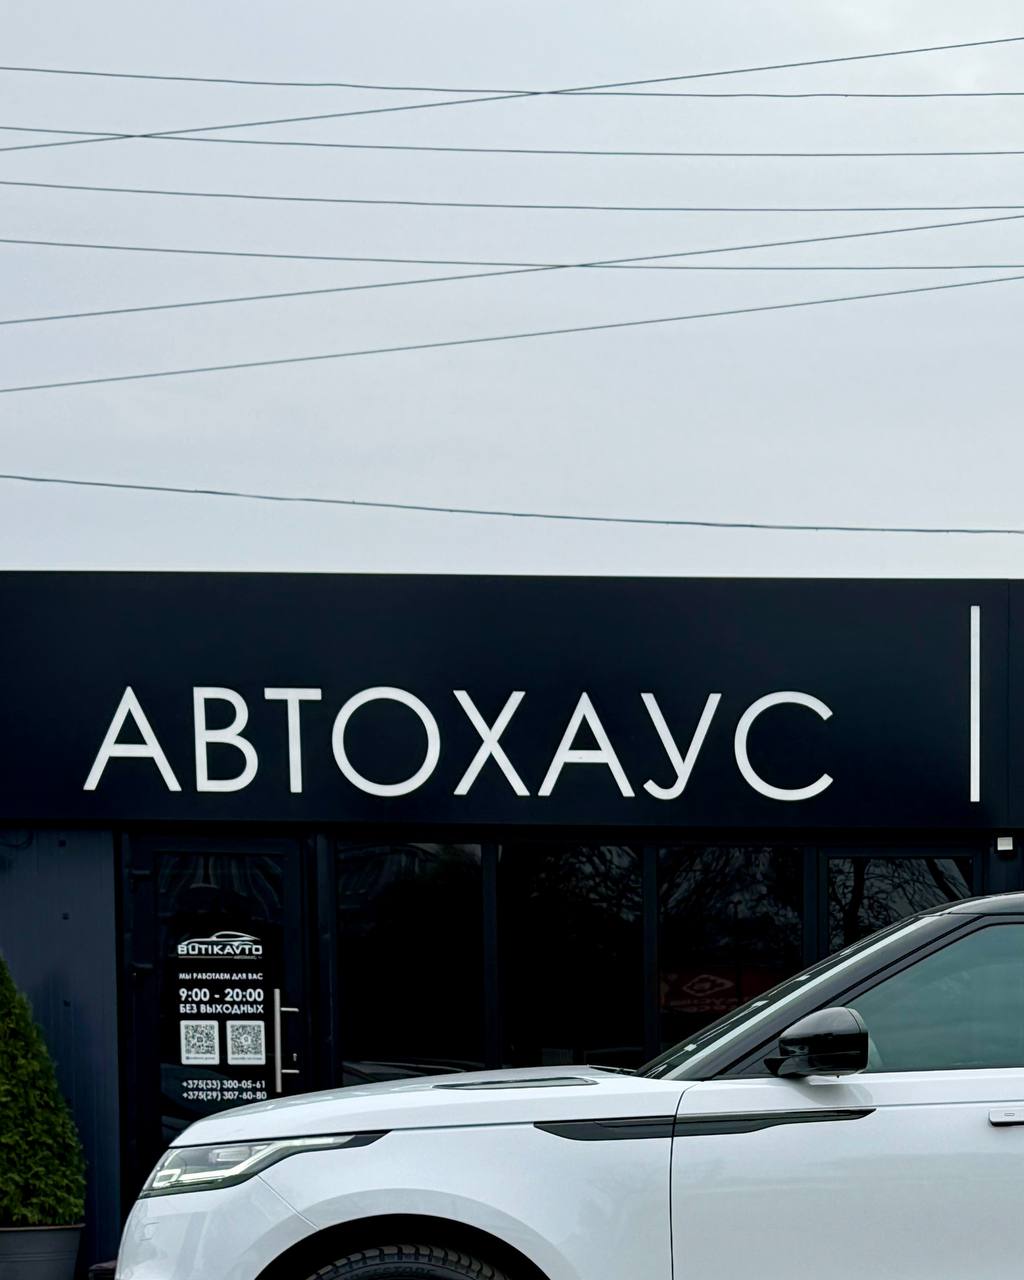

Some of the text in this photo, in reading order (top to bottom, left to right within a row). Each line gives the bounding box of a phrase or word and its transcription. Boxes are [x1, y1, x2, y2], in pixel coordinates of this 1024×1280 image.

[83, 685, 834, 801] АВТОХАУС
[177, 944, 263, 955] BUTIKAVTO
[231, 973, 247, 981] ДЛЯ
[179, 988, 210, 1002] 9:00
[224, 988, 265, 1002] 20:00
[179, 1004, 265, 1015] БЕЗ ВЫХОДНЫХ
[182, 1080, 266, 1090] +375(33) 300-05-61
[182, 1091, 268, 1101] +375(29) 307-60-80
